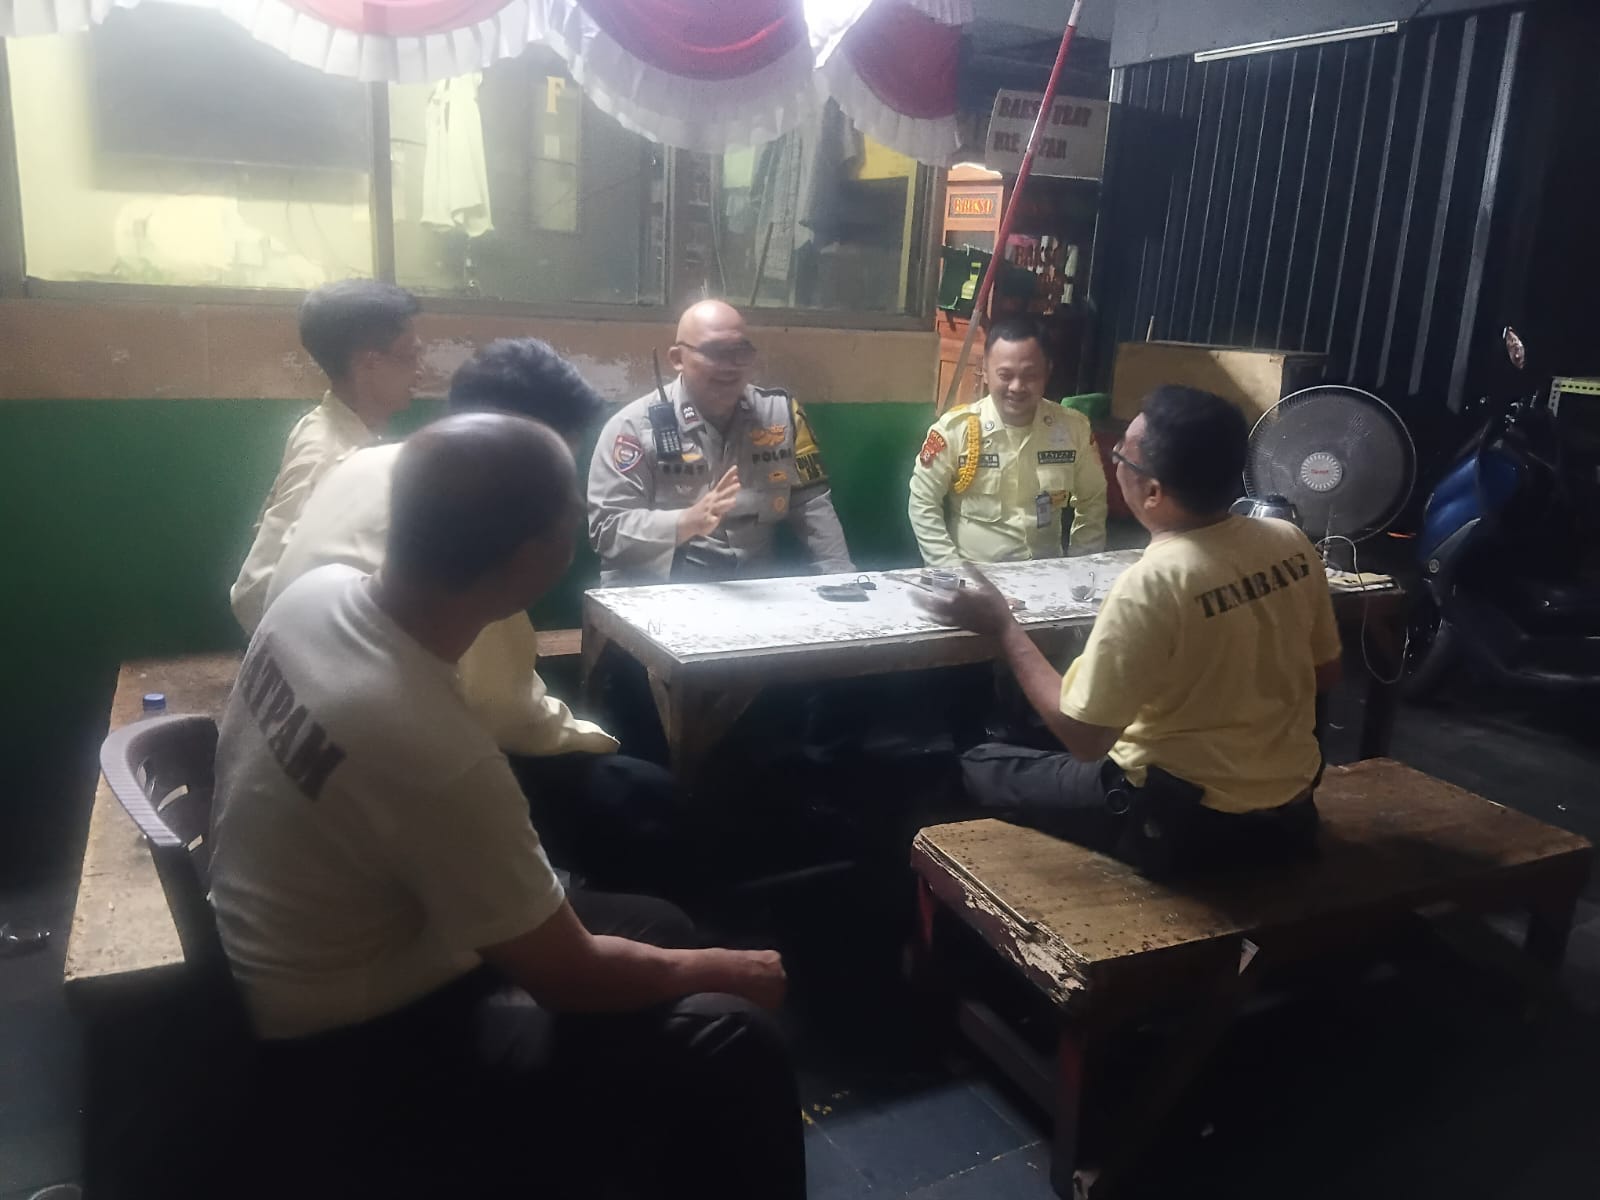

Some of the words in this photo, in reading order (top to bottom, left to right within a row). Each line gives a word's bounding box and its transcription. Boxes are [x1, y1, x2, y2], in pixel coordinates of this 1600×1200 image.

[998, 97, 1043, 120] BAKS
[751, 447, 792, 464] POLRI
[1194, 552, 1310, 619] TEMBANG
